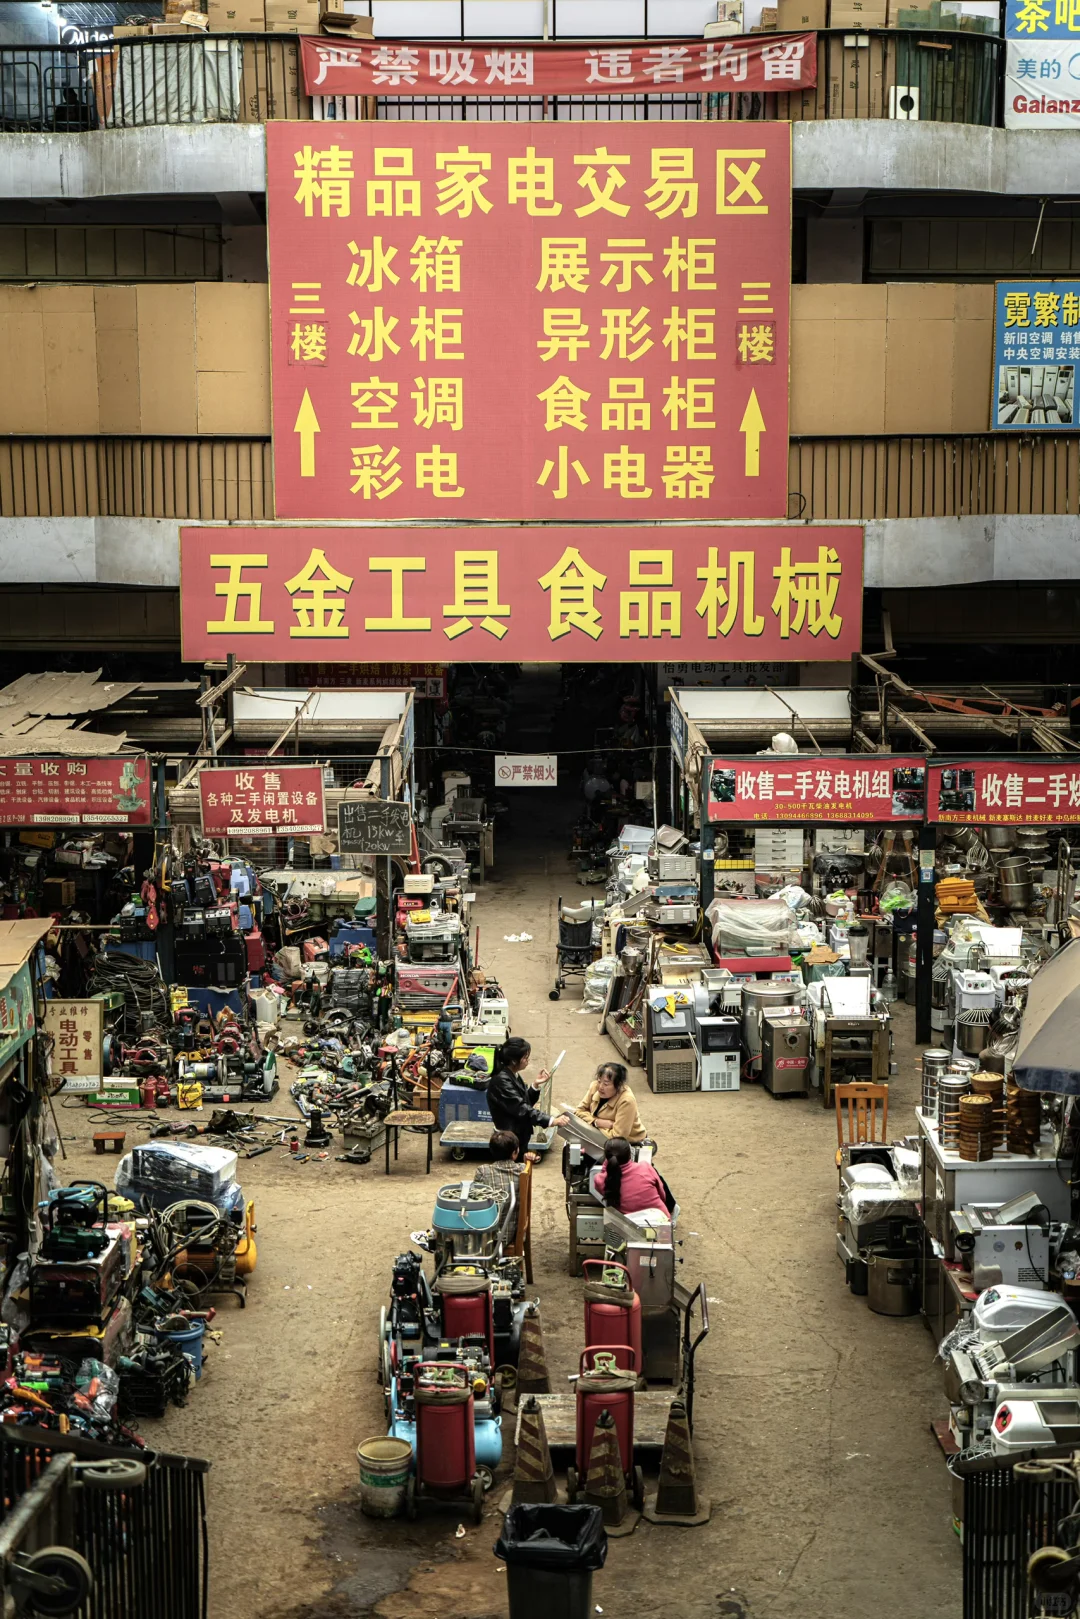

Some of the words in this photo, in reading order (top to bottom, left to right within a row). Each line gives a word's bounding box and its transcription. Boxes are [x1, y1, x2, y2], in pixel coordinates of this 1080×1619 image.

[314, 46, 534, 86] 严禁吸烟
[585, 41, 805, 84] 违者拘留
[1016, 58, 1061, 79] 美的
[1013, 95, 1080, 113] Galanz
[293, 145, 769, 219] 精品家电交易区
[346, 236, 464, 293] 冰箱
[535, 236, 717, 293] 展示柜
[347, 306, 465, 362] 冰柜
[536, 306, 717, 362] 异形柜
[1003, 331, 1053, 345] 新旧空调
[1003, 347, 1080, 360] 中央空调安装
[350, 376, 464, 431] 空调
[536, 375, 717, 433] 食品柜
[350, 444, 465, 500] 彩电
[536, 444, 716, 499] 小电器
[206, 547, 511, 641] 五金工具
[537, 546, 843, 641] 食品机械
[663, 662, 785, 674] 怡勇电动工具批发部
[235, 772, 282, 791] 收售
[511, 765, 555, 781] 严禁烟火
[737, 770, 891, 800] 收售二手发电机组
[206, 791, 318, 807] 各种二手闲置设备
[230, 808, 298, 824] 及发电机
[49, 1005, 89, 1016] 专业维修
[59, 1018, 79, 1075] 电动工具
[82, 1030, 93, 1061] 零售
